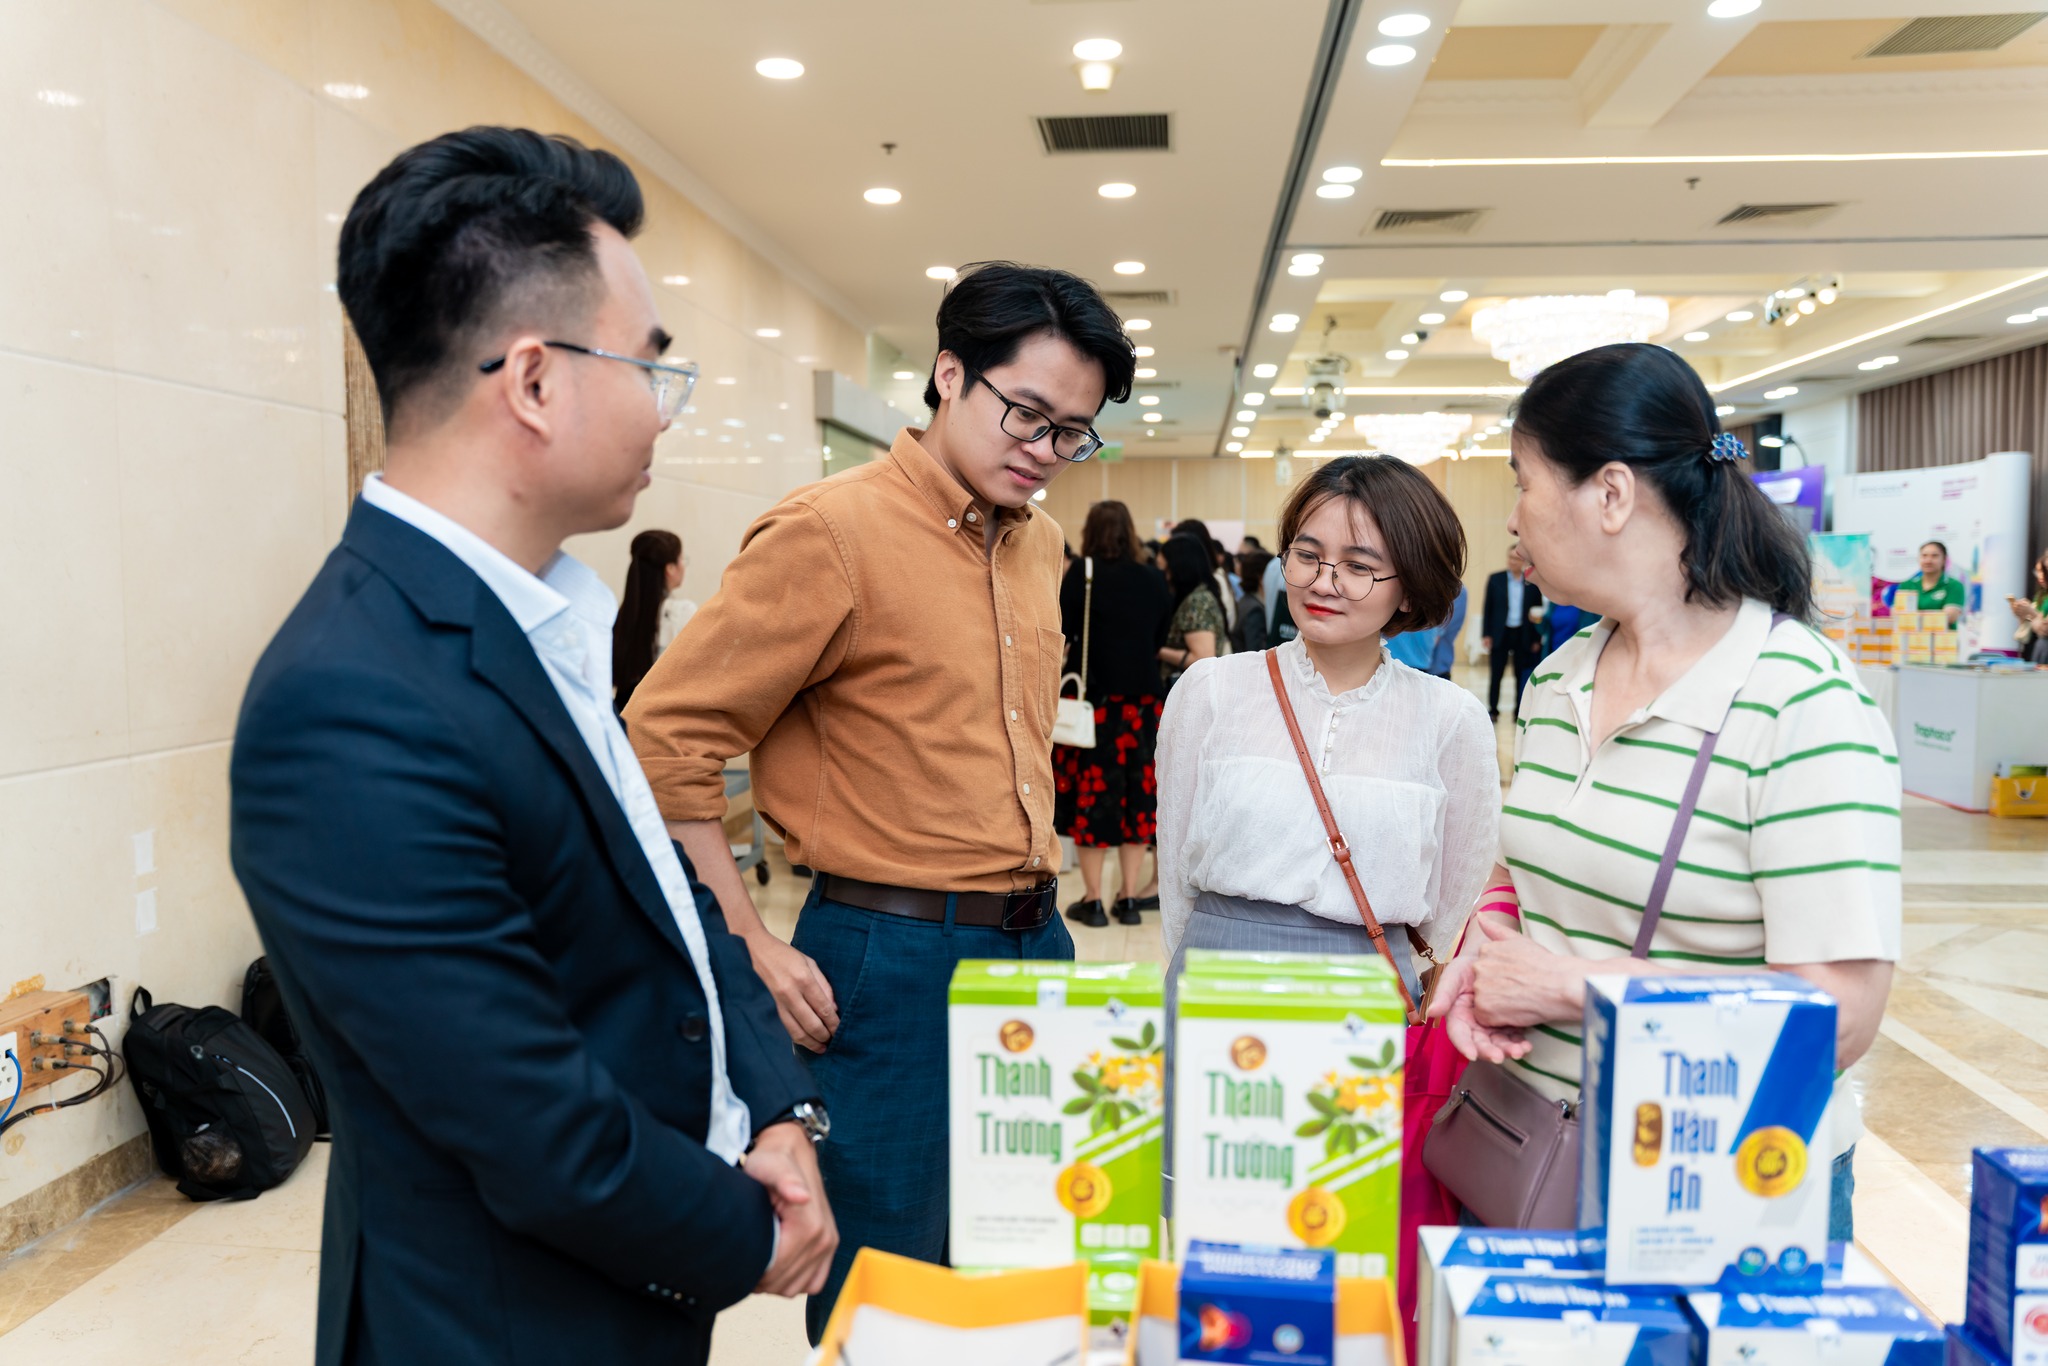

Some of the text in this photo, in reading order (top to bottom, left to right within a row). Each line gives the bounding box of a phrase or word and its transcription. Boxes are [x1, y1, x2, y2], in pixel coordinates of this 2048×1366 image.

[976, 1053, 1053, 1102] Thanh
[1204, 1071, 1284, 1123] Thanh
[1660, 1050, 1739, 1102] Thanh
[1670, 1109, 1718, 1162] Hậu
[1666, 1164, 1702, 1215] An
